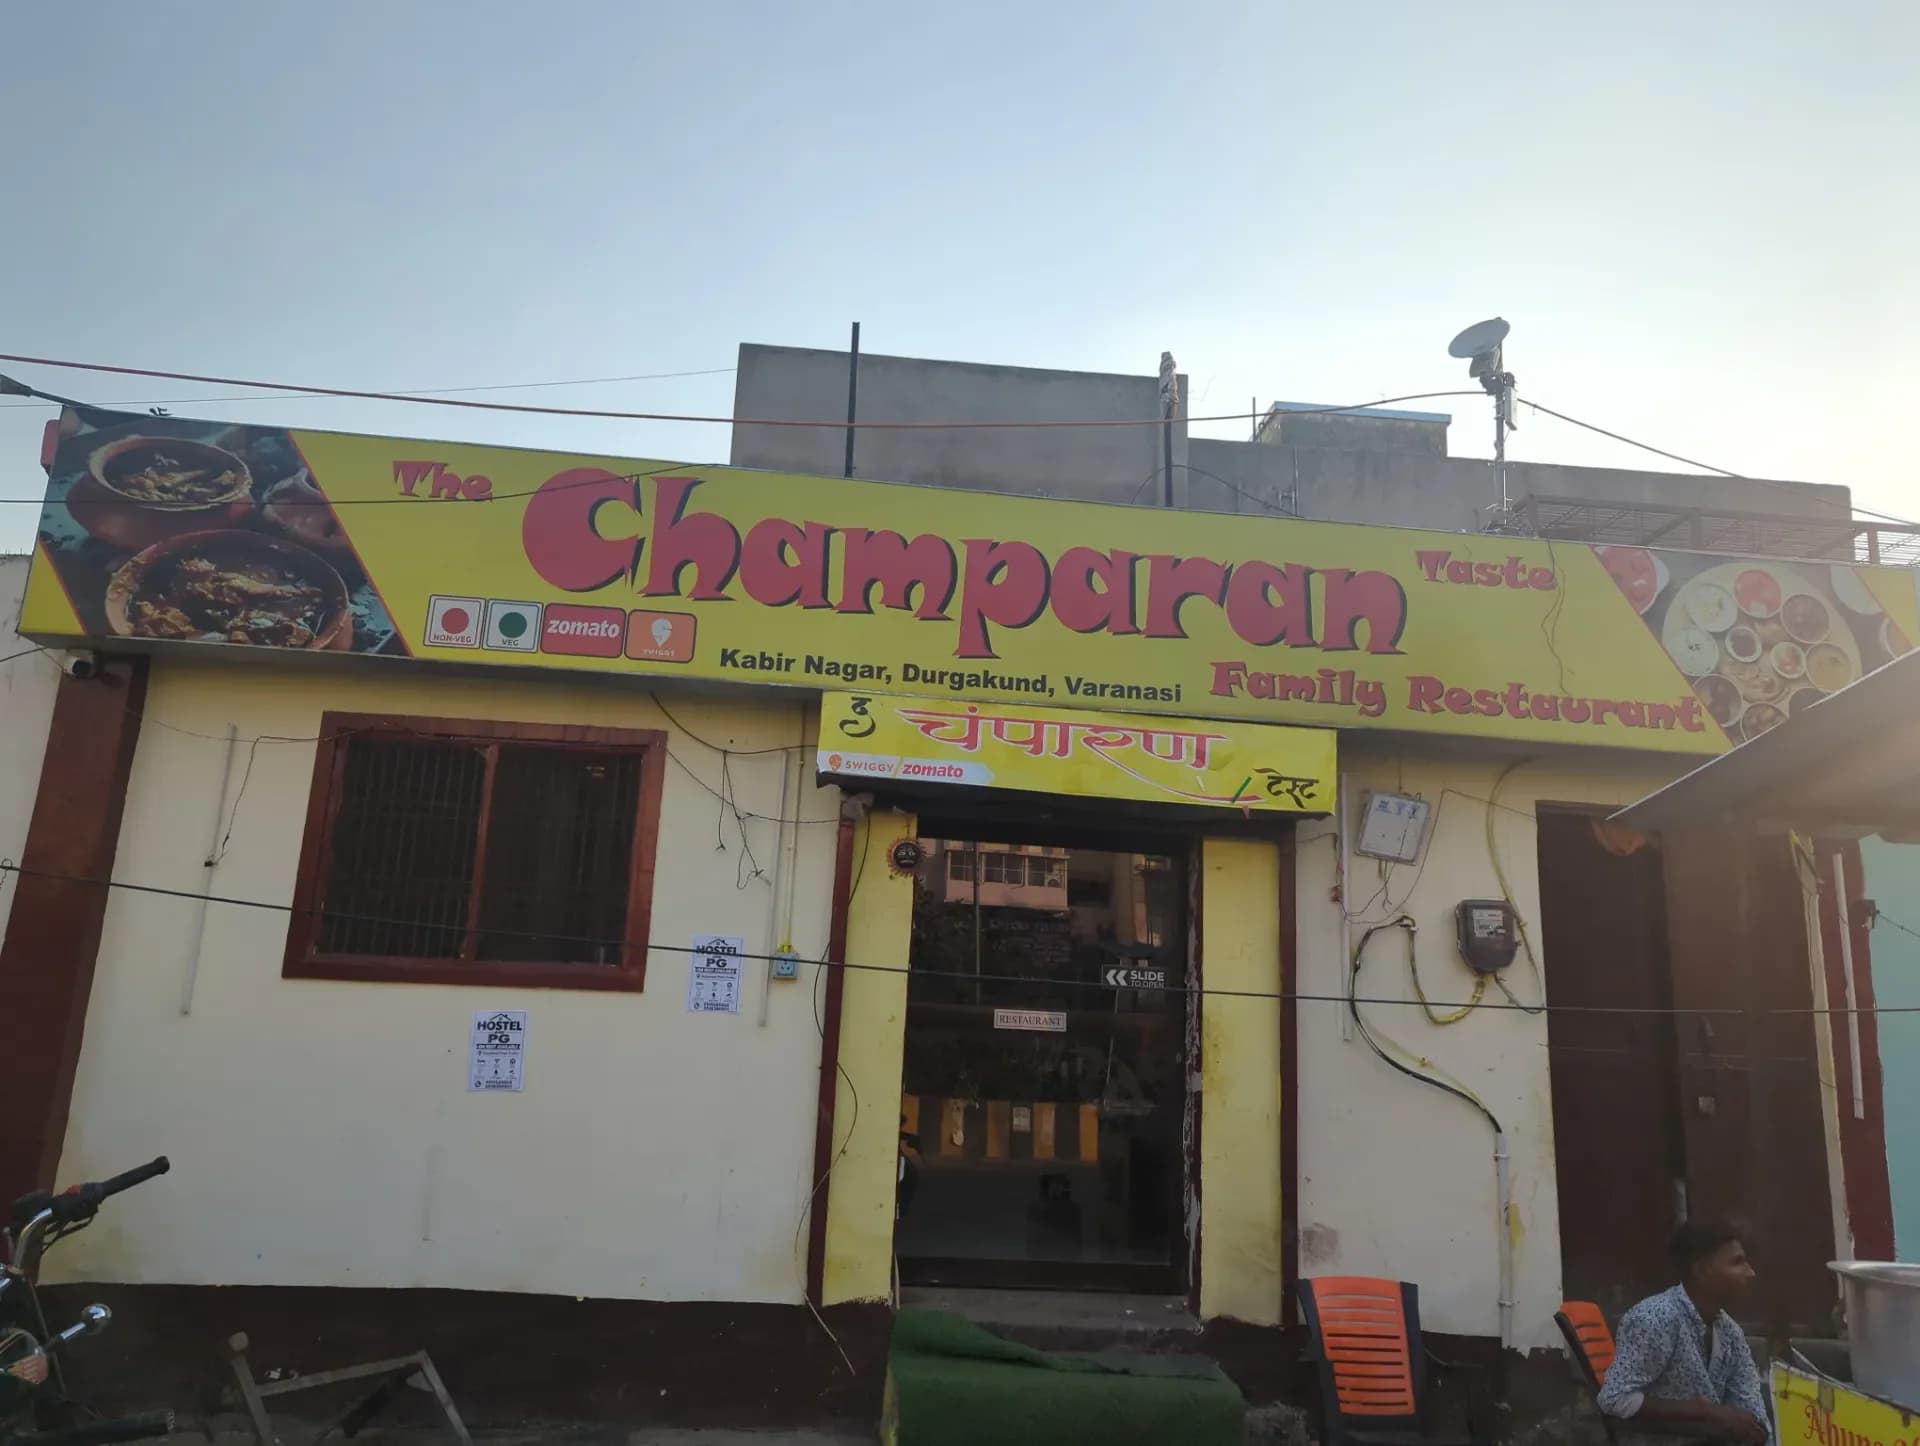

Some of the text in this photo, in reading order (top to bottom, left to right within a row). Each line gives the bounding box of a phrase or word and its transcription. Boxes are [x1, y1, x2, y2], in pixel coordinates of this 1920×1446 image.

[392, 461, 493, 502] The
[522, 466, 1407, 659] Champaran
[1415, 550, 1558, 591] Taste
[546, 619, 620, 638] zomato
[433, 633, 473, 643] NON-VEG
[501, 638, 519, 646] VEG
[719, 648, 1182, 702] Kabir Nagar, Durgakund, Varanasi
[1208, 661, 1705, 732] Family Restaurant
[898, 706, 1263, 802] चंपारण
[845, 760, 895, 773] SWIGGY
[902, 762, 964, 778] zomato
[1252, 767, 1320, 808] टेस्ट
[706, 958, 727, 968] PG
[1130, 970, 1165, 982] SLIDE
[477, 1021, 522, 1031] HOSTEL
[999, 1015, 1061, 1025] RESTAURANT
[488, 1034, 510, 1043] PG
[1803, 1405, 1884, 1446] Ahu
